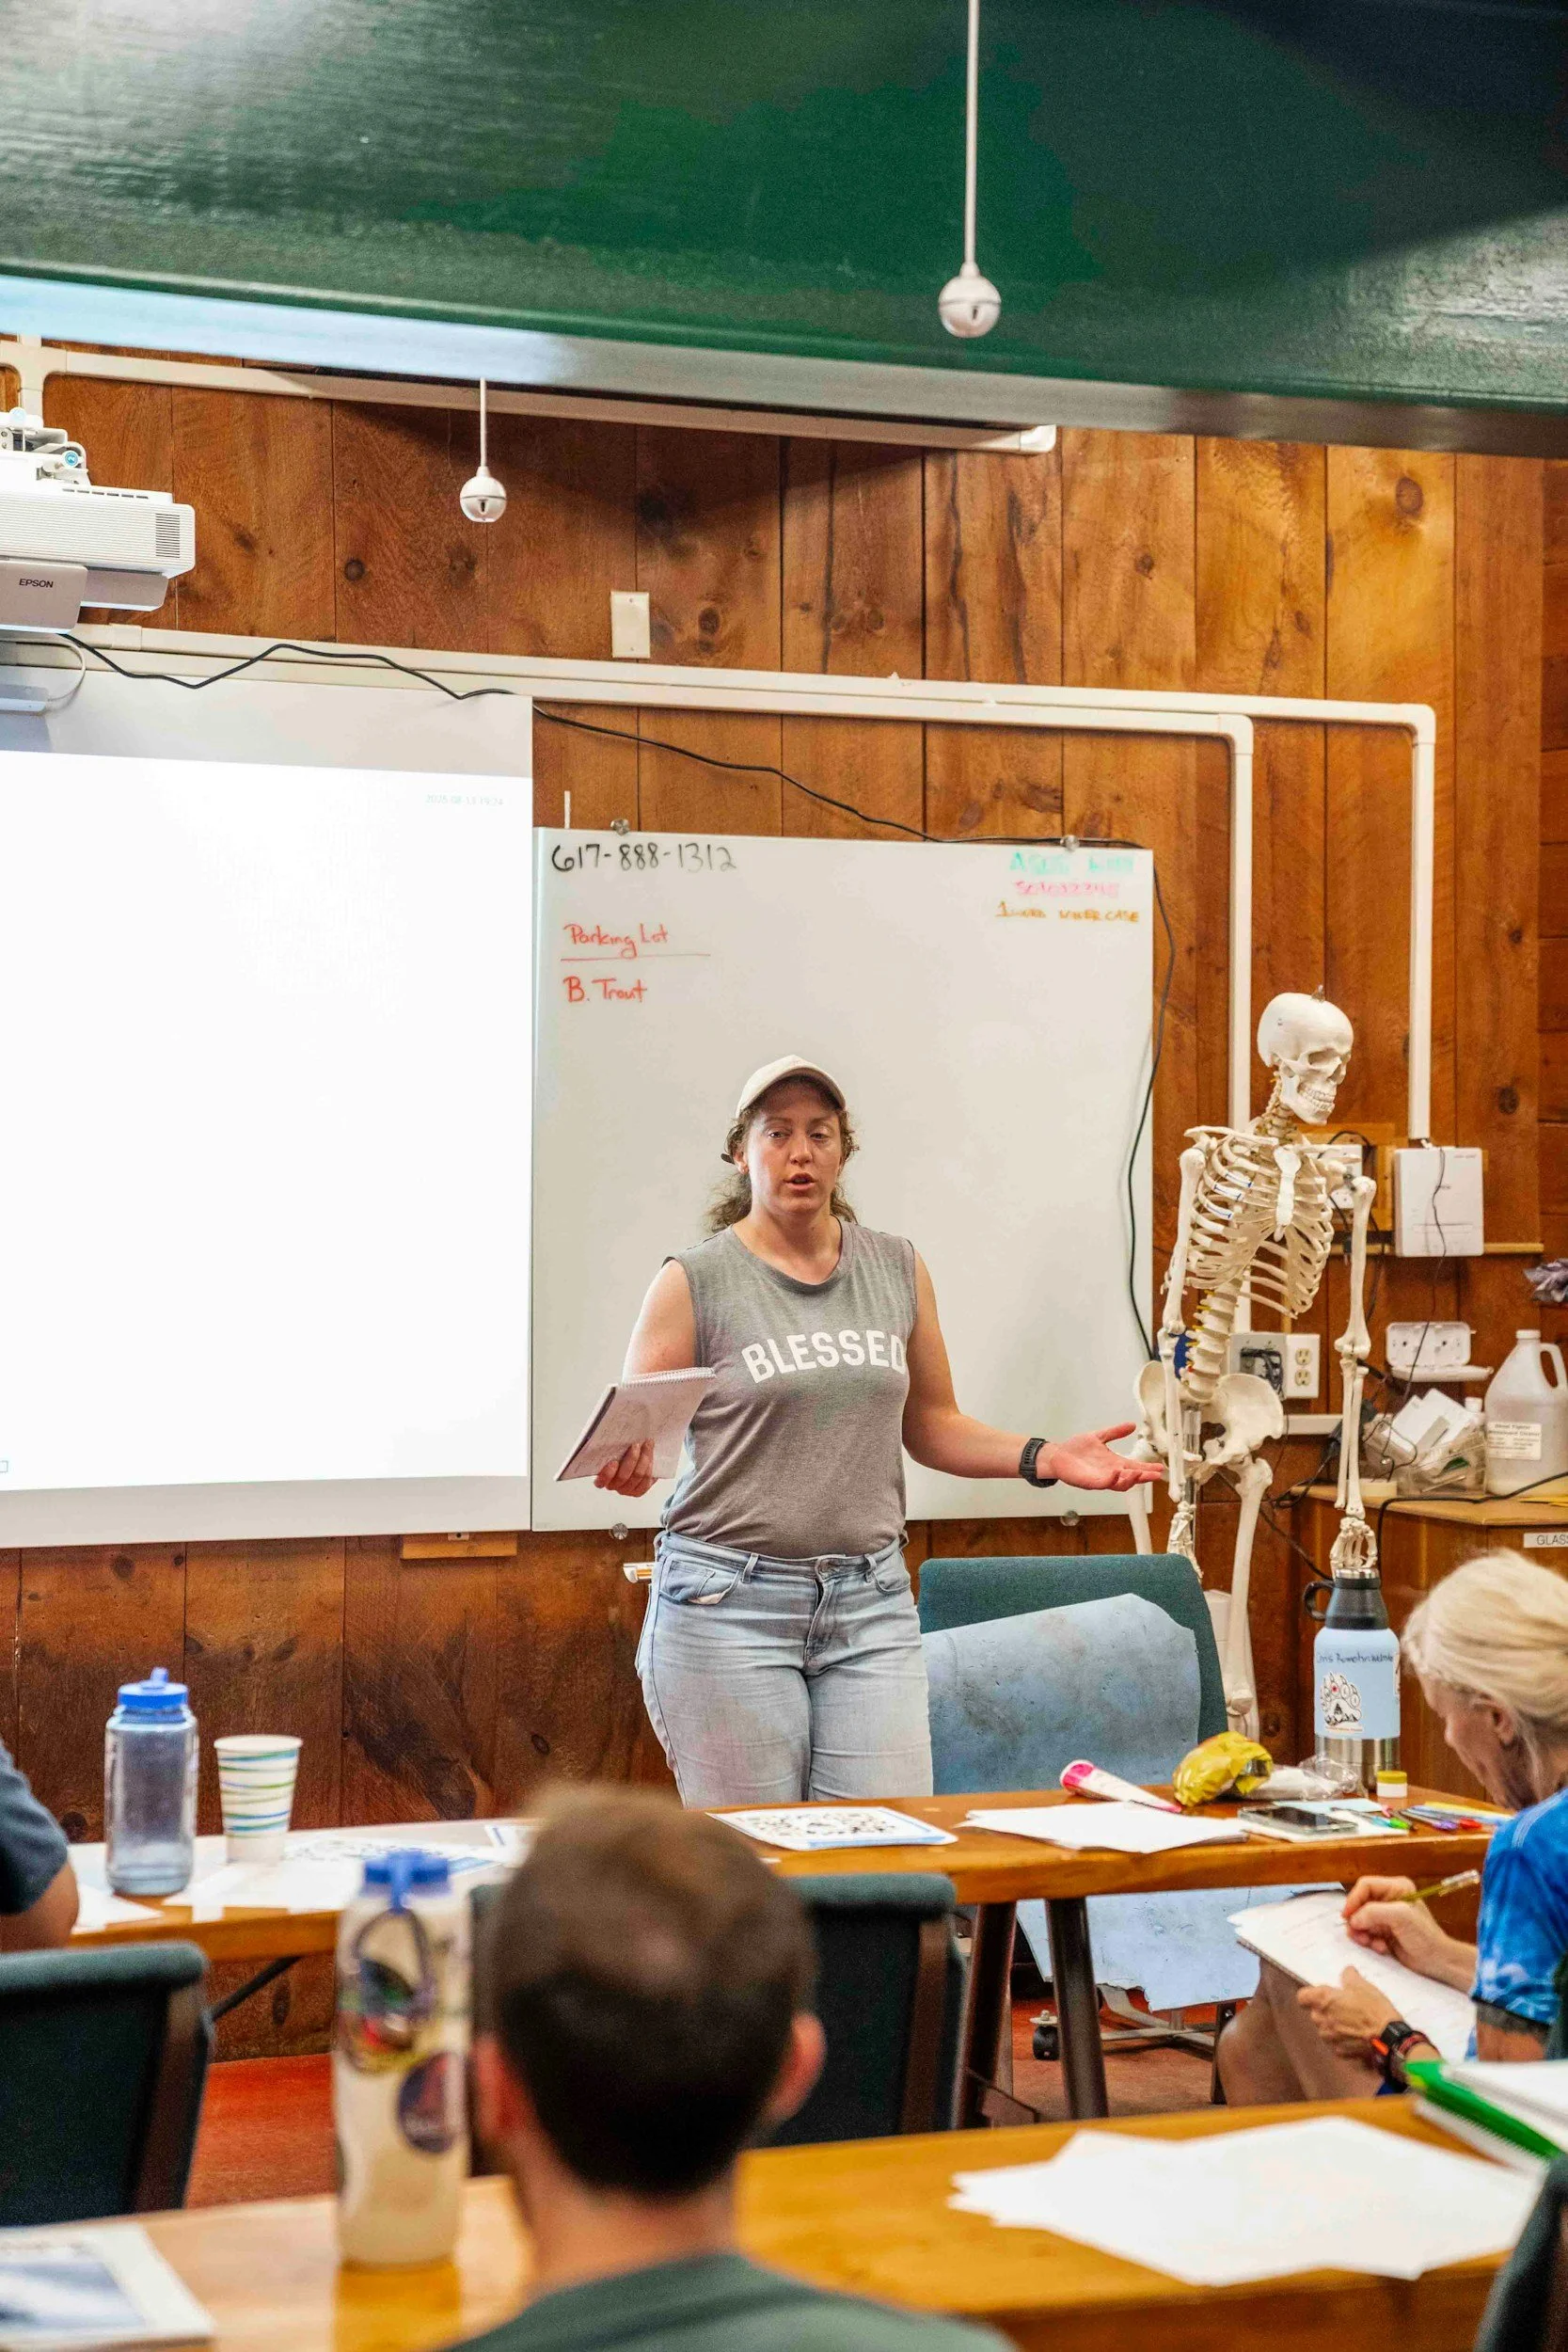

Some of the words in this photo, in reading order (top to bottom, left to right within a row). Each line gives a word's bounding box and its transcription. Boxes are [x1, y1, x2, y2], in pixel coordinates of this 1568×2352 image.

[19, 578, 54, 588] EPSON
[552, 842, 737, 873] 617-888-1312
[562, 923, 639, 960] Parking
[640, 922, 670, 944] Lot
[562, 976, 591, 1003] B.
[592, 978, 648, 1003] Trout
[741, 1329, 908, 1384] BLESSED
[1536, 1534, 1568, 1546] GLAS
